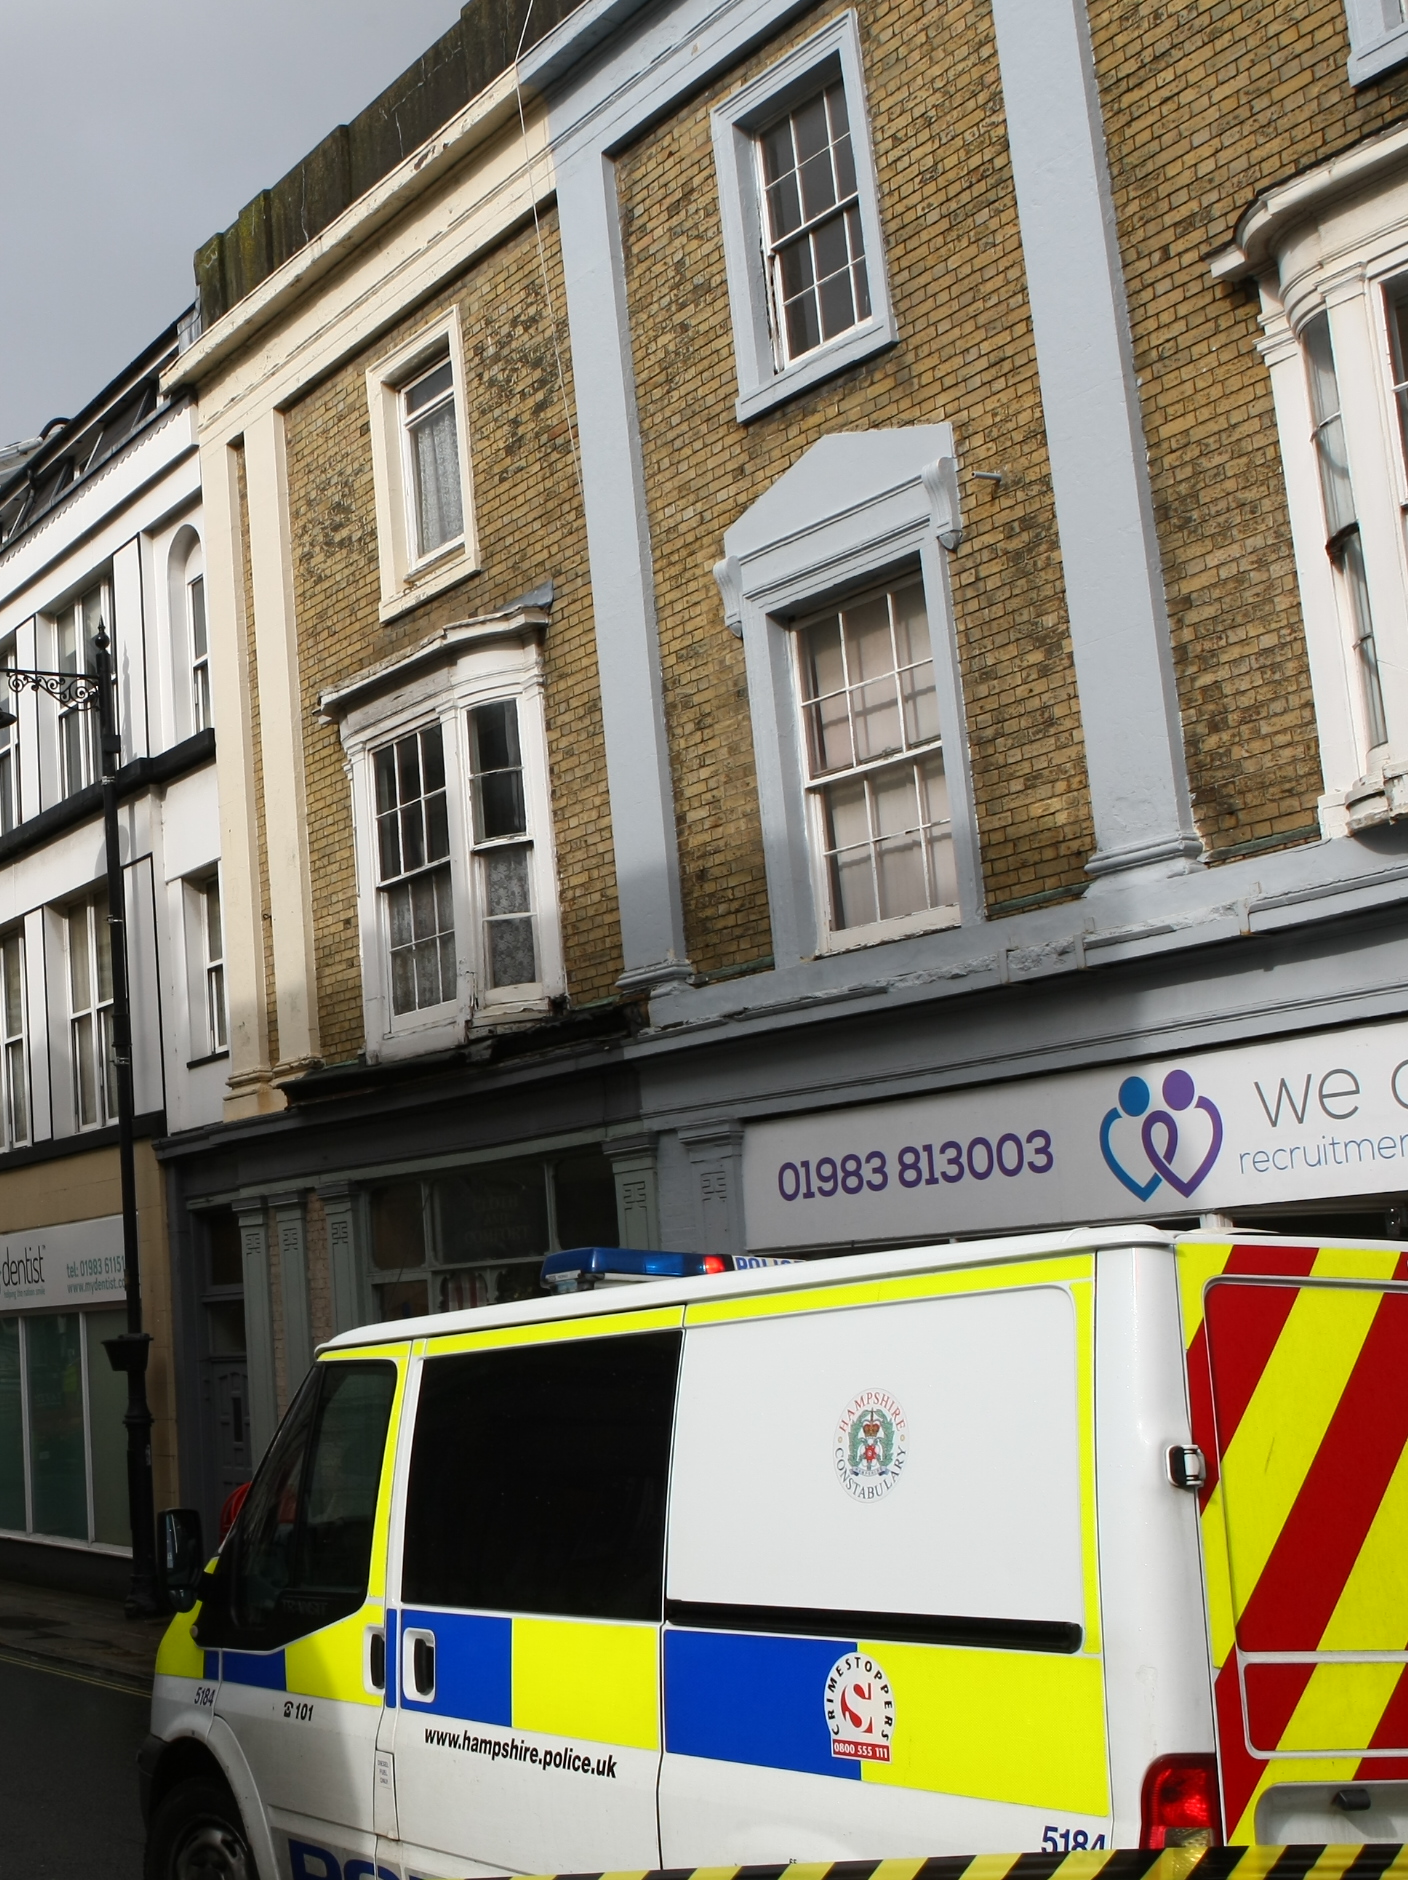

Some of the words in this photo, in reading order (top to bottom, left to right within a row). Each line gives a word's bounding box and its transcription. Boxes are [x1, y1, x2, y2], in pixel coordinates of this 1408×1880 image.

[1253, 1068, 1361, 1128] we
[778, 1150, 889, 1202] 01983
[897, 1129, 1054, 1189] 813003
[79, 1258, 102, 1277] 01983
[104, 1255, 125, 1274] 61151
[839, 1391, 906, 1433] HAMPSHIRE
[834, 1445, 907, 1500] CONSTABULARY
[282, 1600, 328, 1616] TRANSIT
[194, 1686, 216, 1707] 5184
[295, 1702, 314, 1722] 101
[826, 1656, 893, 1742] CRIMESTOPPERS
[424, 1727, 618, 1779] www.hampshire.police.uk
[833, 1742, 855, 1754] 0800
[857, 1745, 873, 1757] 555
[874, 1747, 888, 1759] 111
